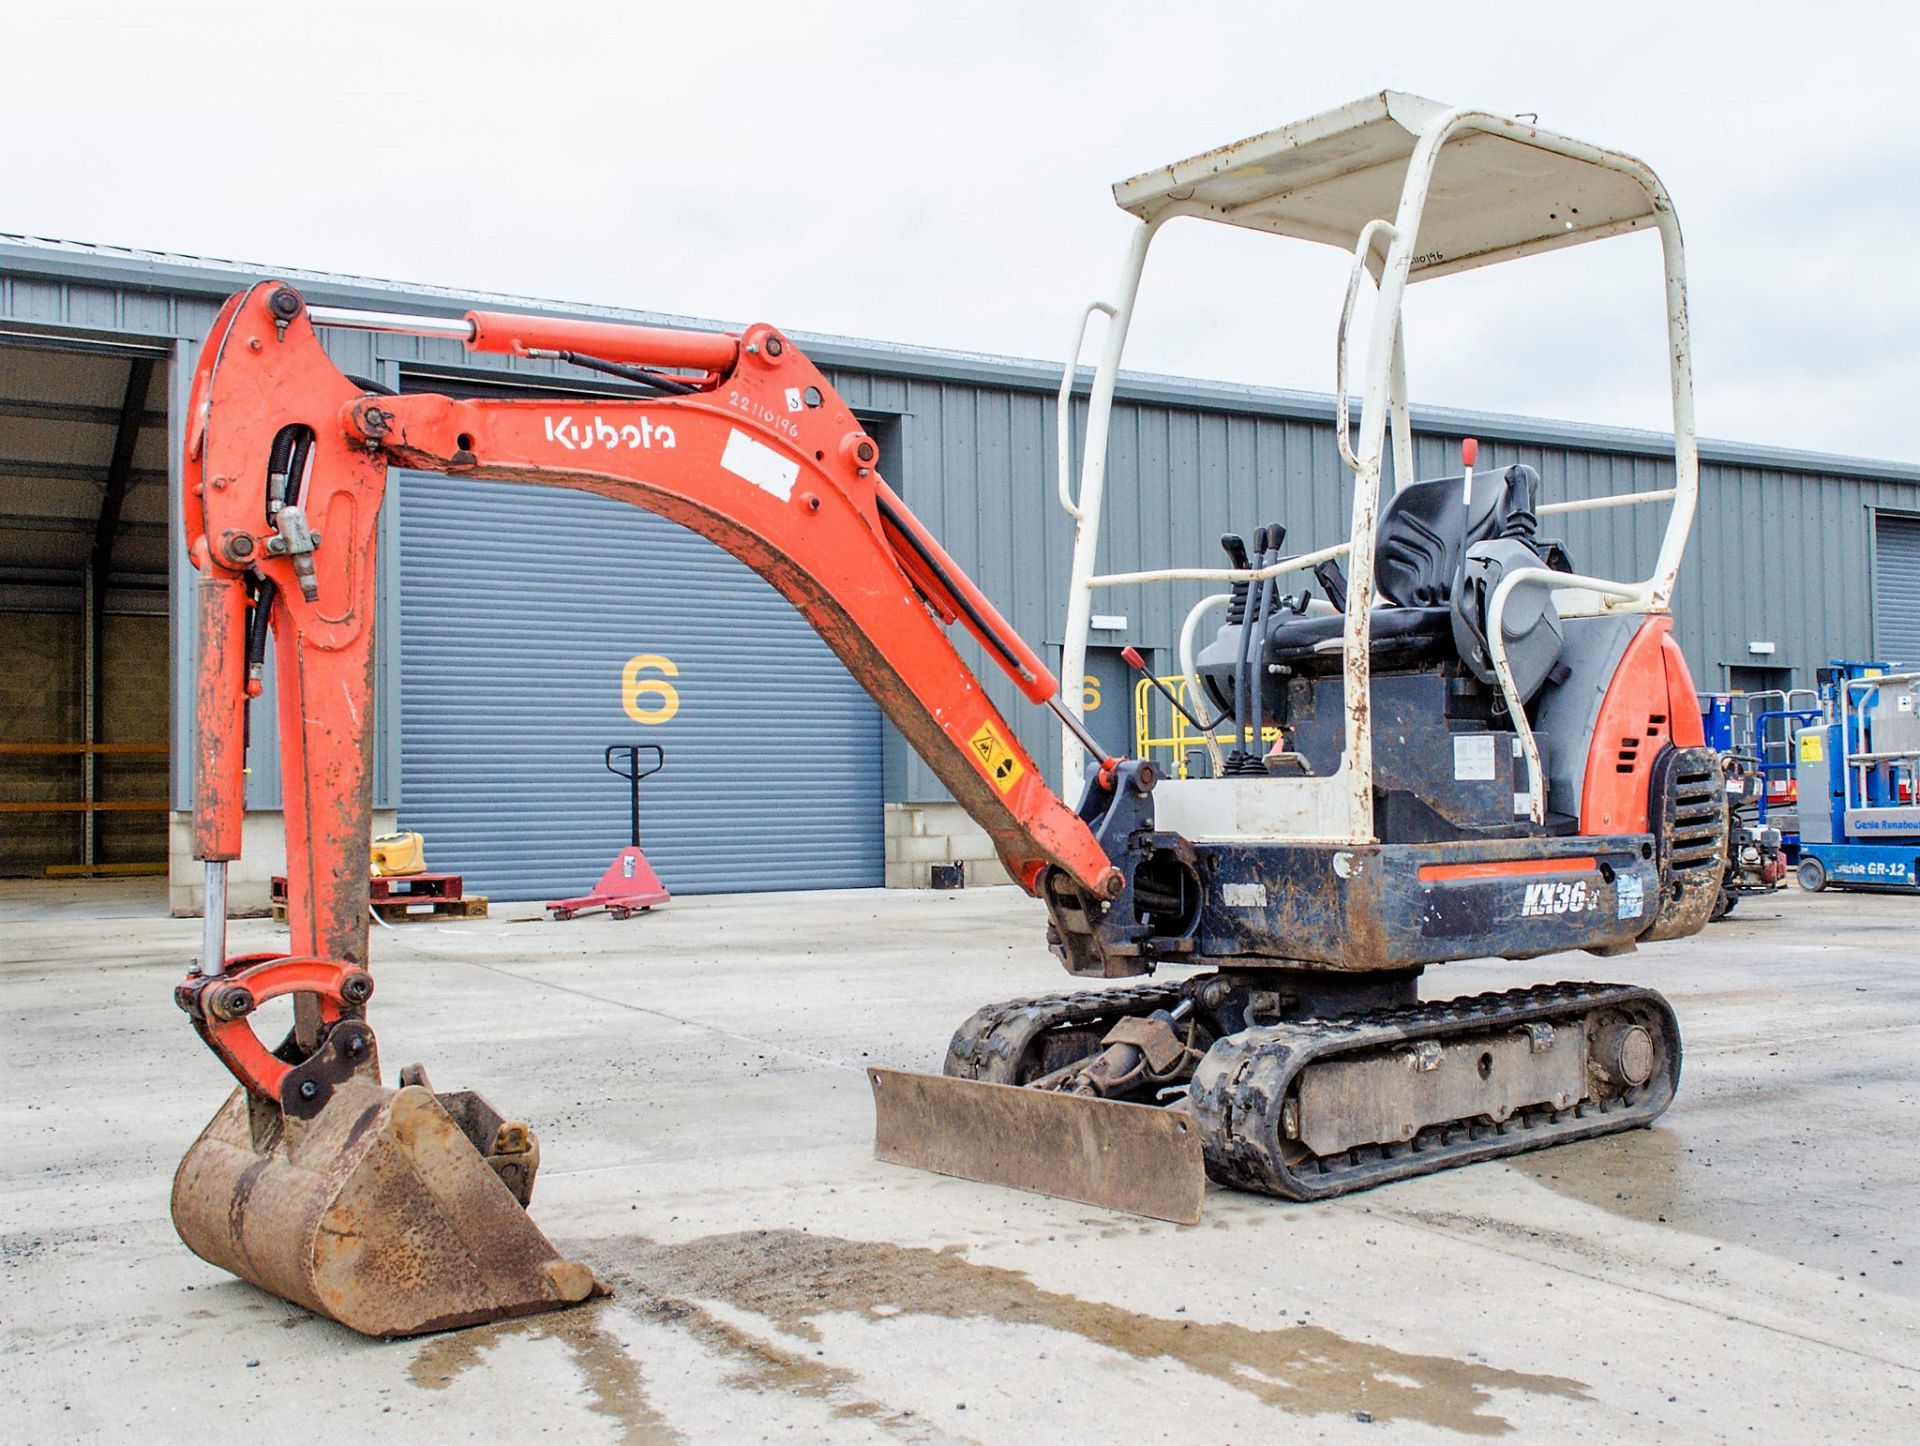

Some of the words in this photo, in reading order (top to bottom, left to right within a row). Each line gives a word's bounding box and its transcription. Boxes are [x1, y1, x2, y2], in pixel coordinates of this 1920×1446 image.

[728, 390, 799, 437] 22110196
[544, 415, 676, 449] Kubota
[622, 654, 679, 724] 6
[1855, 820, 1879, 830] Genie
[1867, 862, 1906, 876] GR-12
